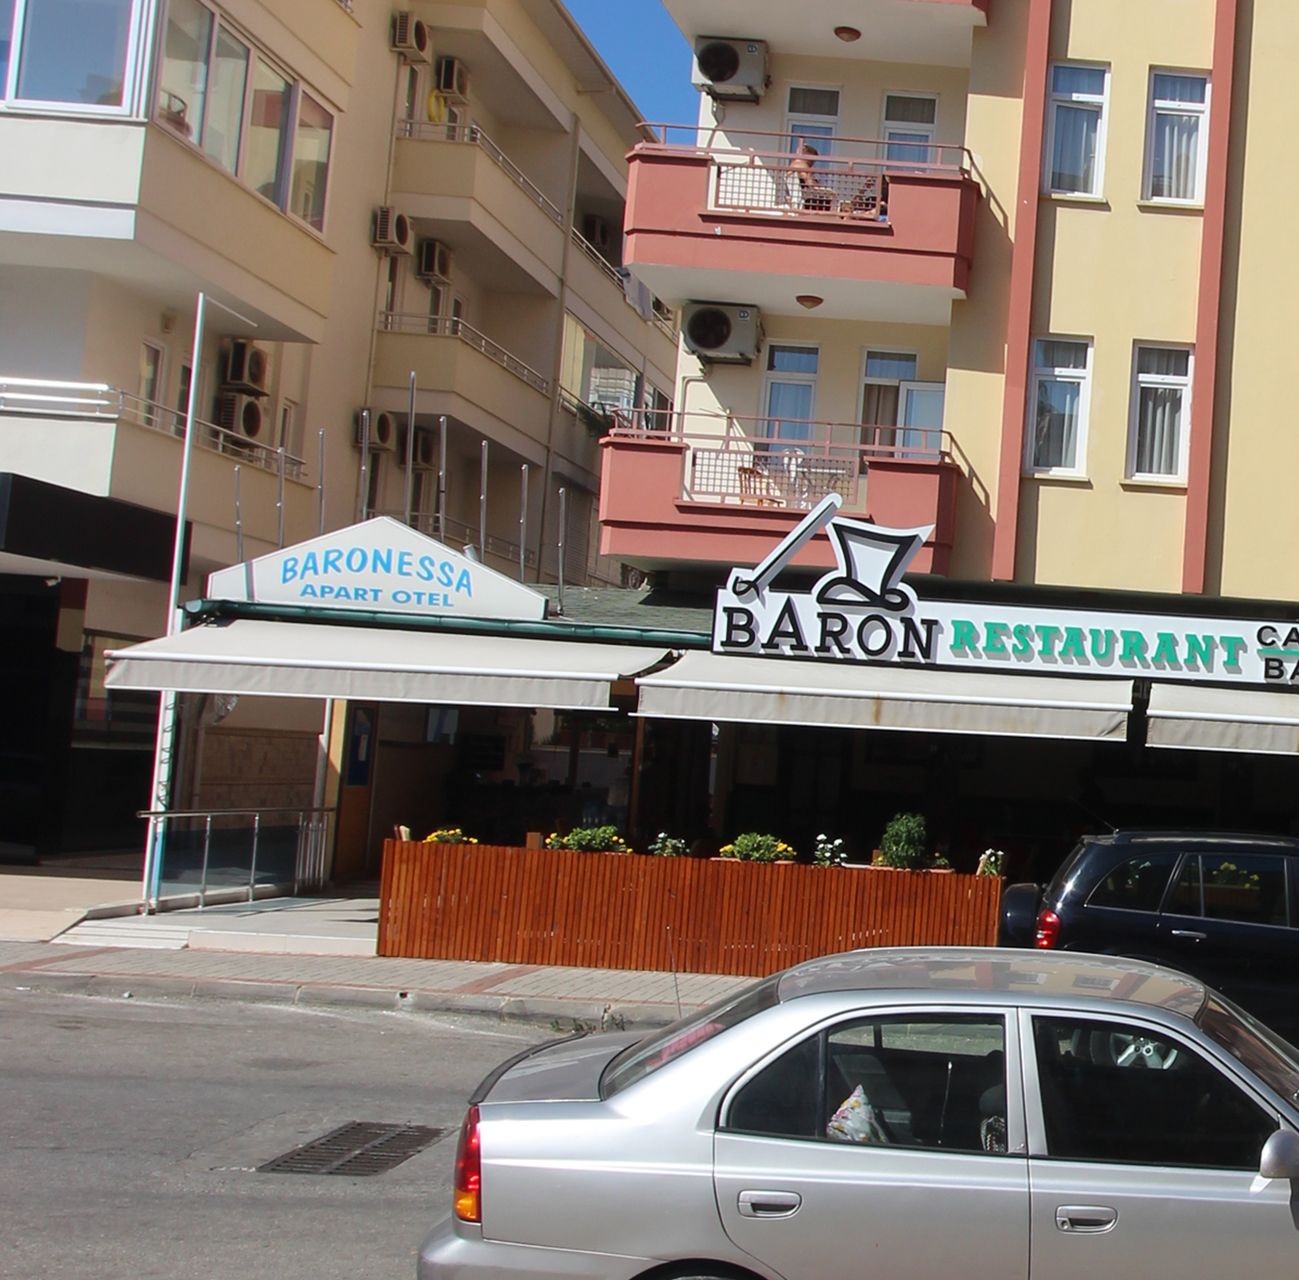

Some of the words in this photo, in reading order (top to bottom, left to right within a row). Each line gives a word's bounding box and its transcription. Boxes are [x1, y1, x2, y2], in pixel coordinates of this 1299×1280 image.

[281, 547, 474, 598] BARONESSA
[299, 583, 382, 602] APART
[391, 590, 455, 608] OTEL
[721, 597, 940, 660] BARON
[950, 619, 1246, 670] RESTAURANT
